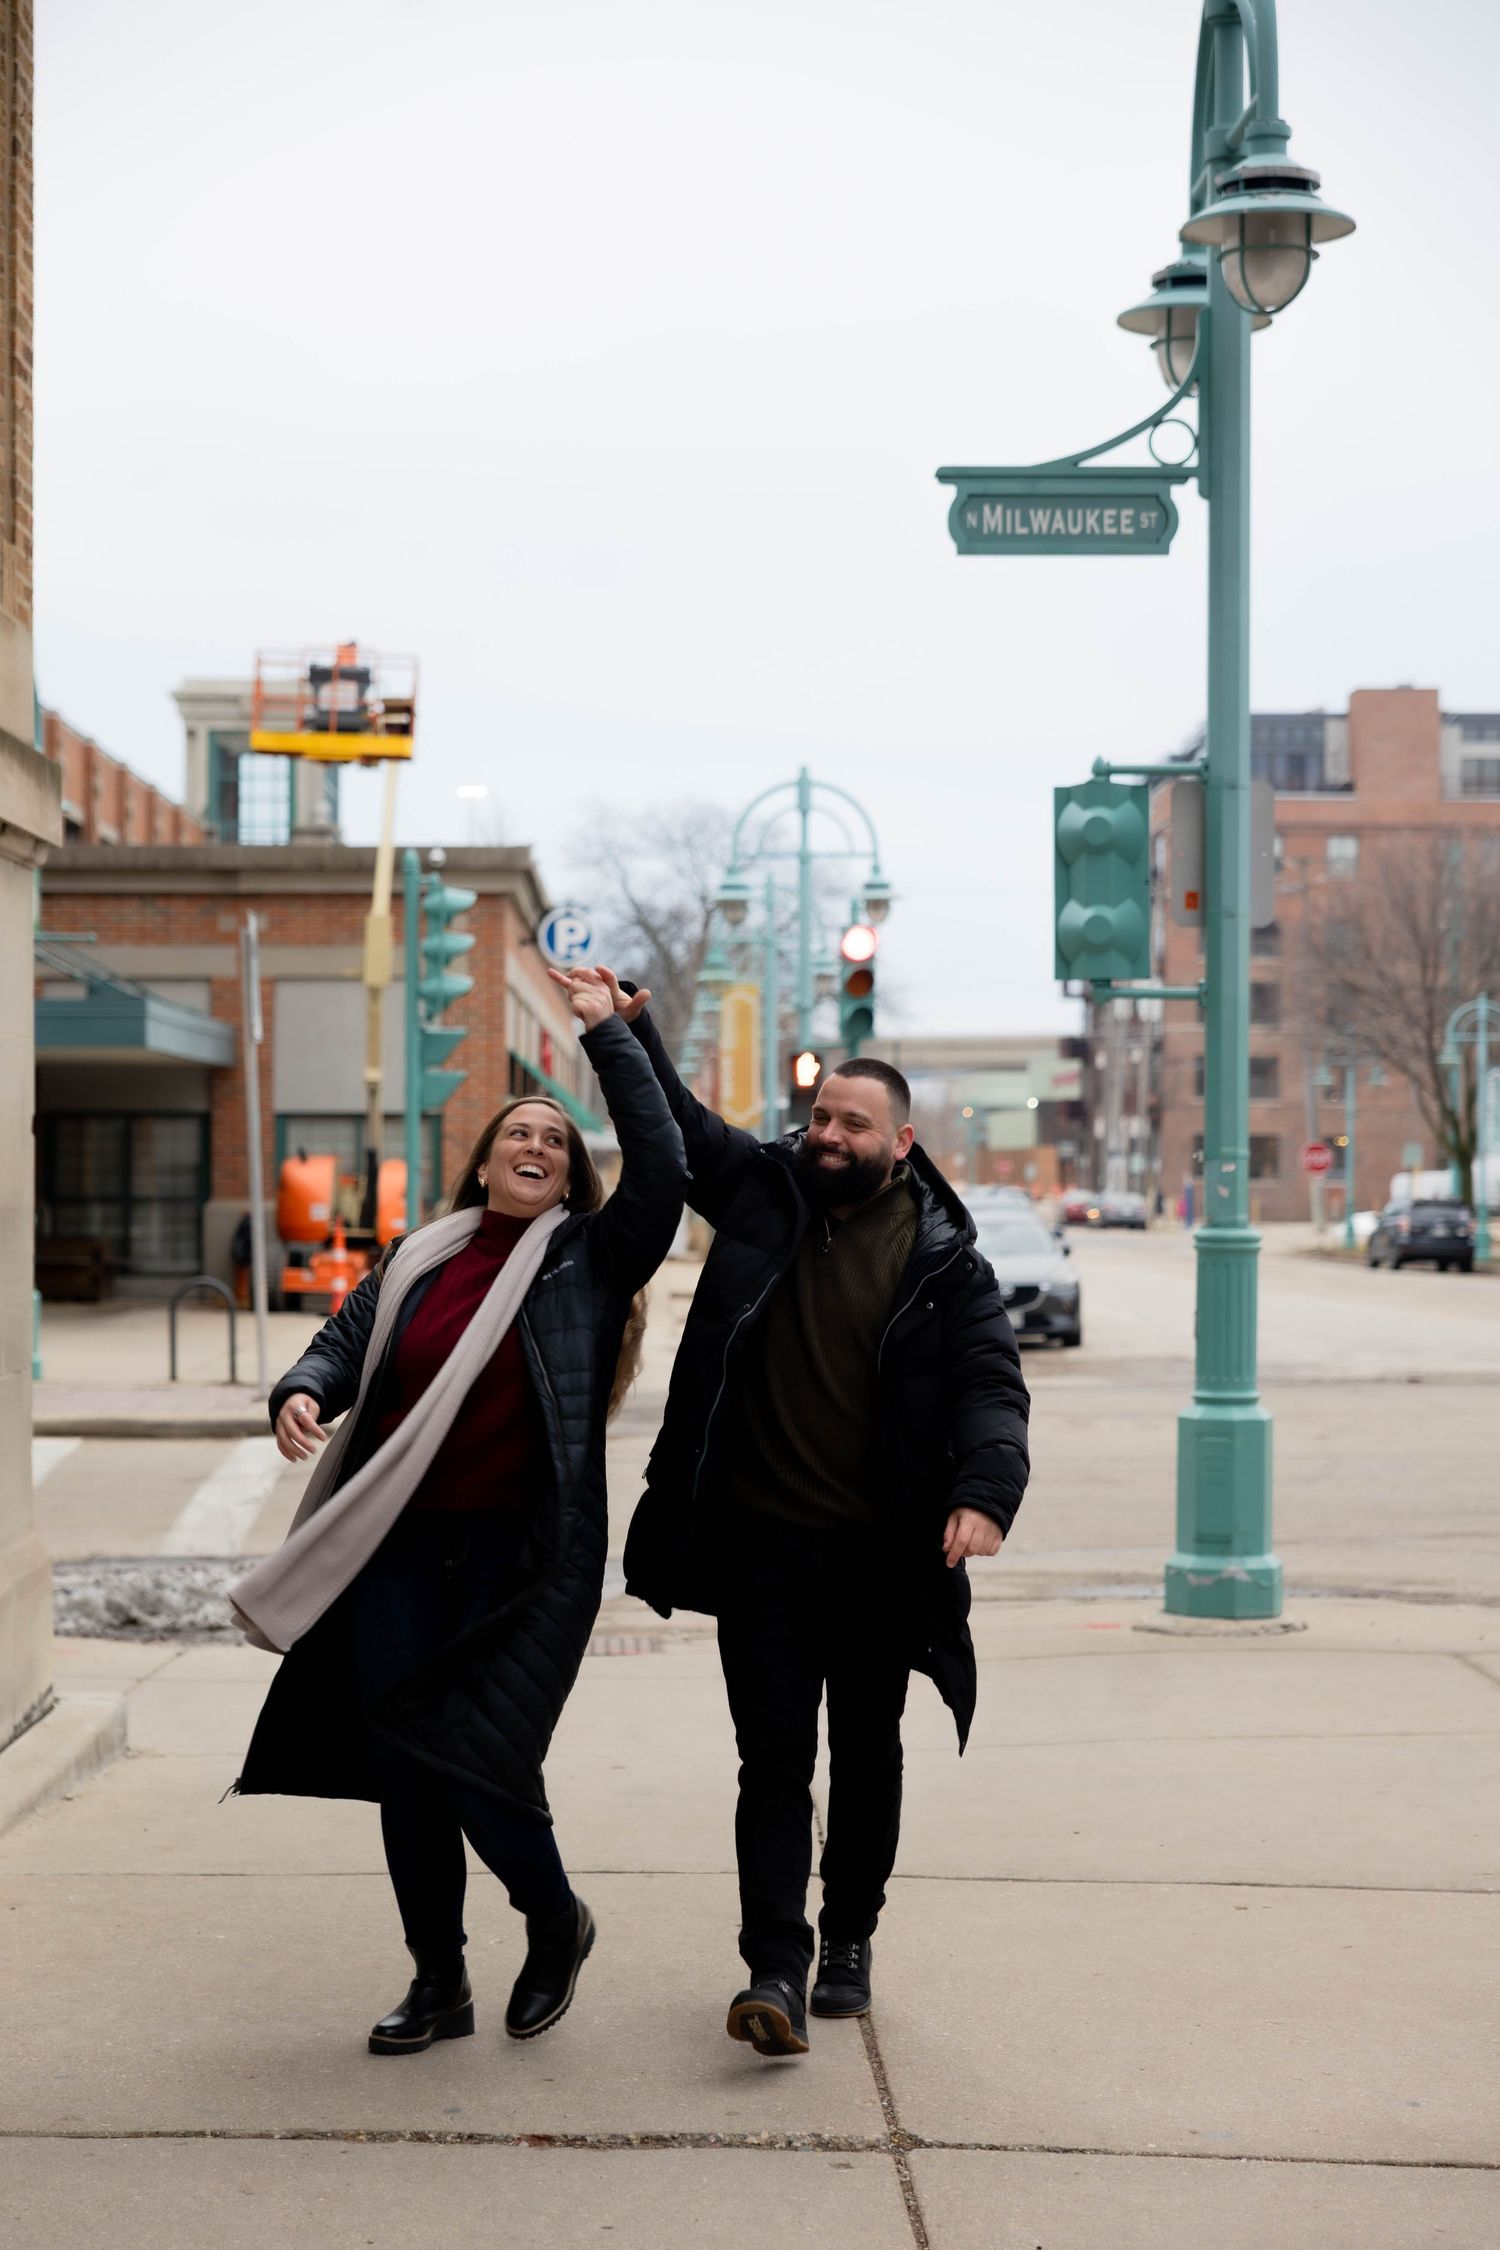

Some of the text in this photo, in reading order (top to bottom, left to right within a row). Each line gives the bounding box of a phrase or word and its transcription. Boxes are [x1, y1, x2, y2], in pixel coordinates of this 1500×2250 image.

[967, 504, 1158, 535] N MILWAUKEE ST
[555, 918, 589, 957] P
